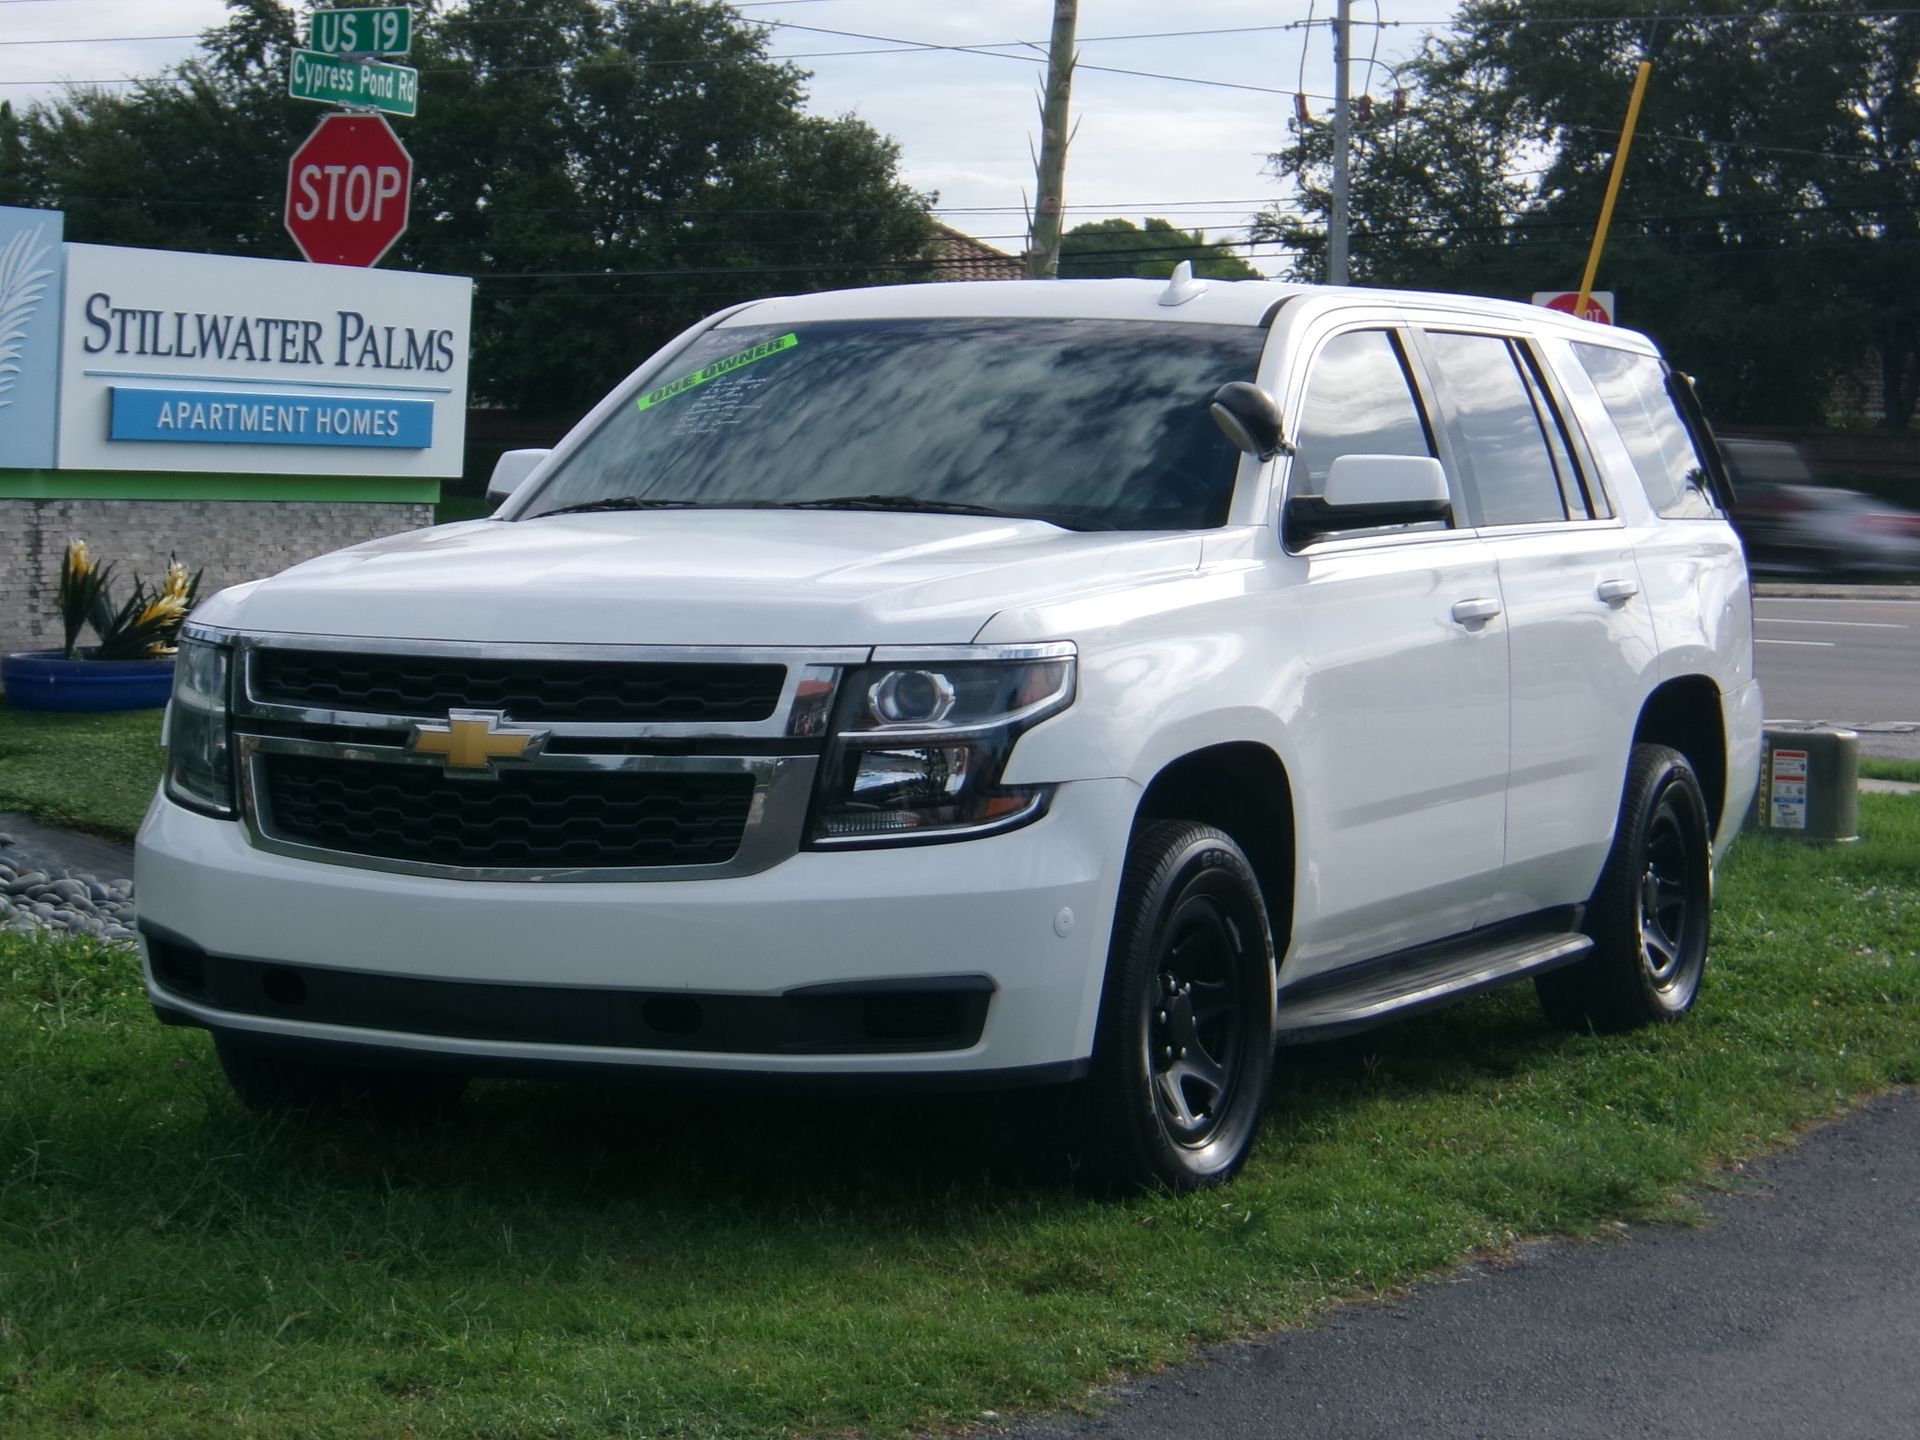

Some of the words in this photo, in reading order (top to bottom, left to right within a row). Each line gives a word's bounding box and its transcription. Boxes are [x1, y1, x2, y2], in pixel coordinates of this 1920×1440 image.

[321, 13, 358, 53] US
[372, 11, 399, 51] 19
[293, 54, 354, 95] Cypress
[360, 65, 393, 99] Pond
[398, 73, 415, 103] Rd
[295, 163, 402, 222] STOP
[83, 292, 325, 365] STILLWATER
[336, 310, 454, 373] PALMS
[649, 373, 697, 404] ONE
[701, 337, 785, 380] OWNER
[157, 400, 311, 434] APARTMENT
[316, 406, 400, 437] HOMES
